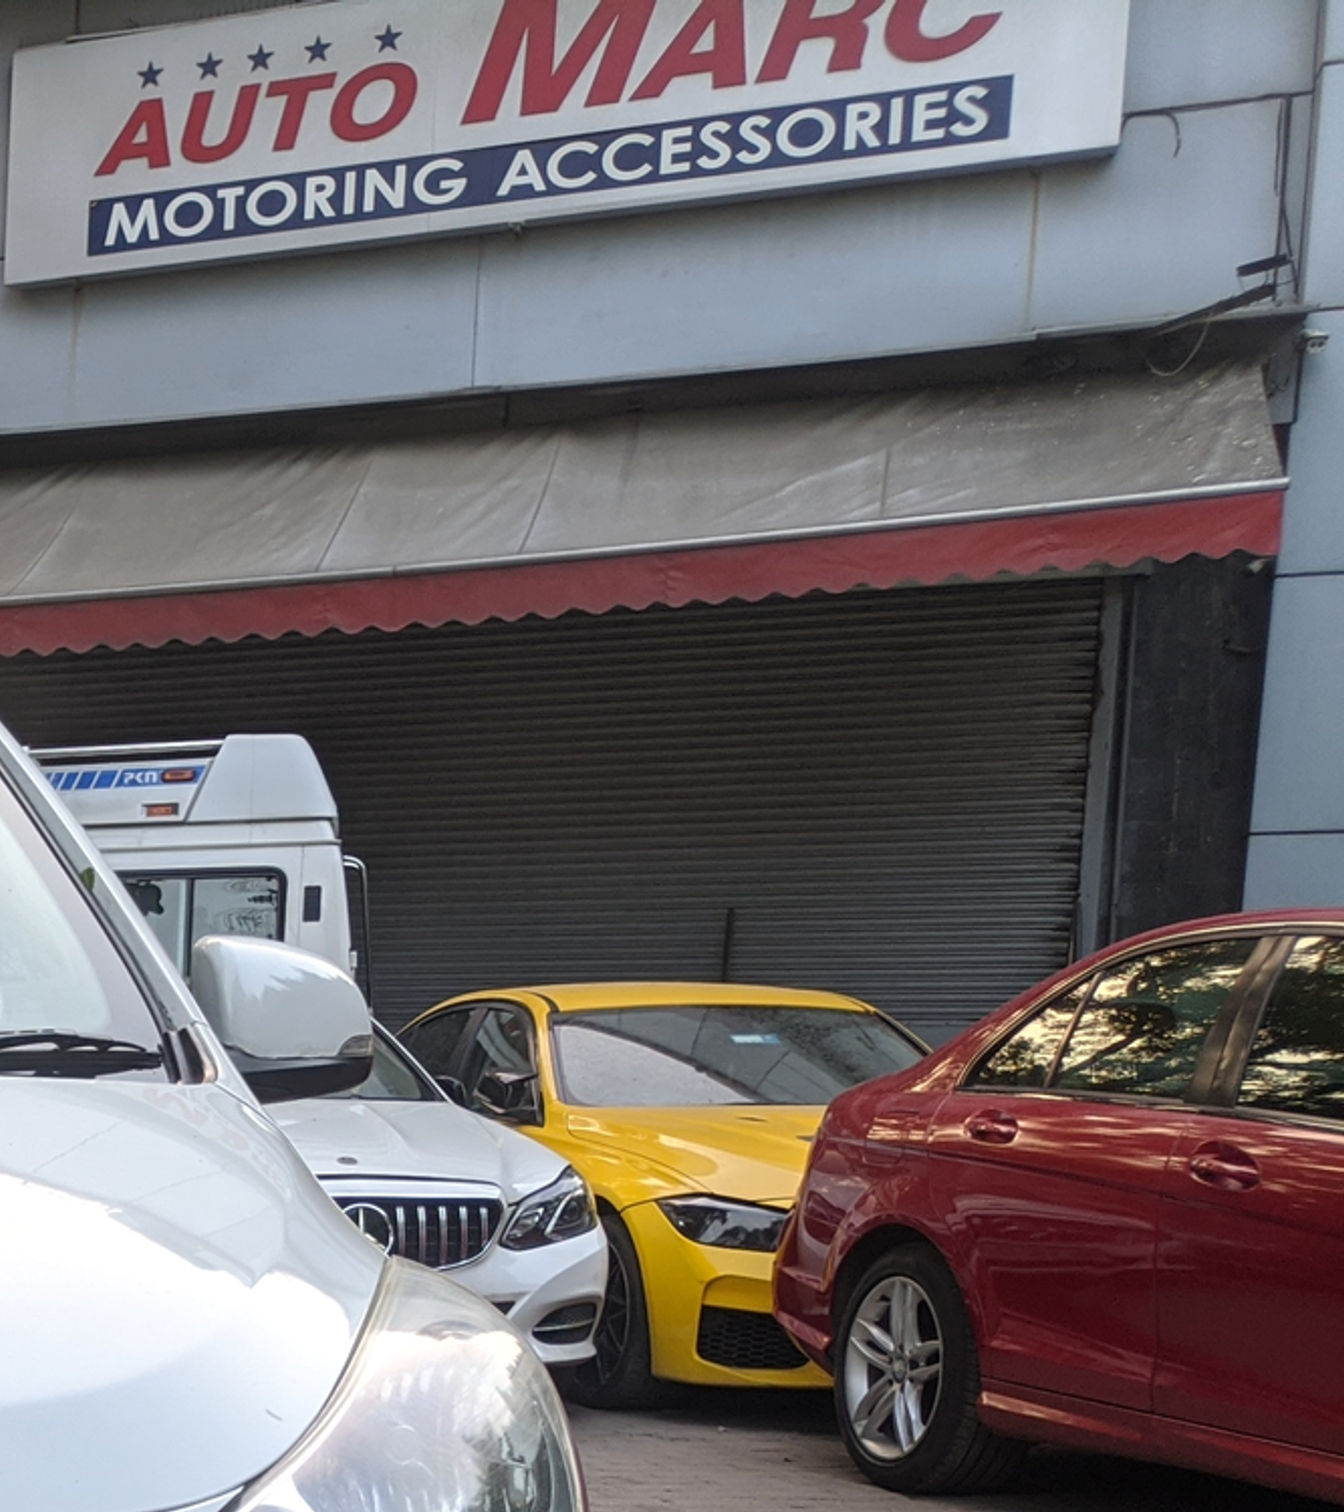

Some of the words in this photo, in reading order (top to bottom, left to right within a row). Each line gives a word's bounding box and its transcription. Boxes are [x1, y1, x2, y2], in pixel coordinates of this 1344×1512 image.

[94, 61, 419, 177] AUTO
[103, 158, 468, 247] MOTORING
[496, 86, 990, 197] ACCESSORIES
